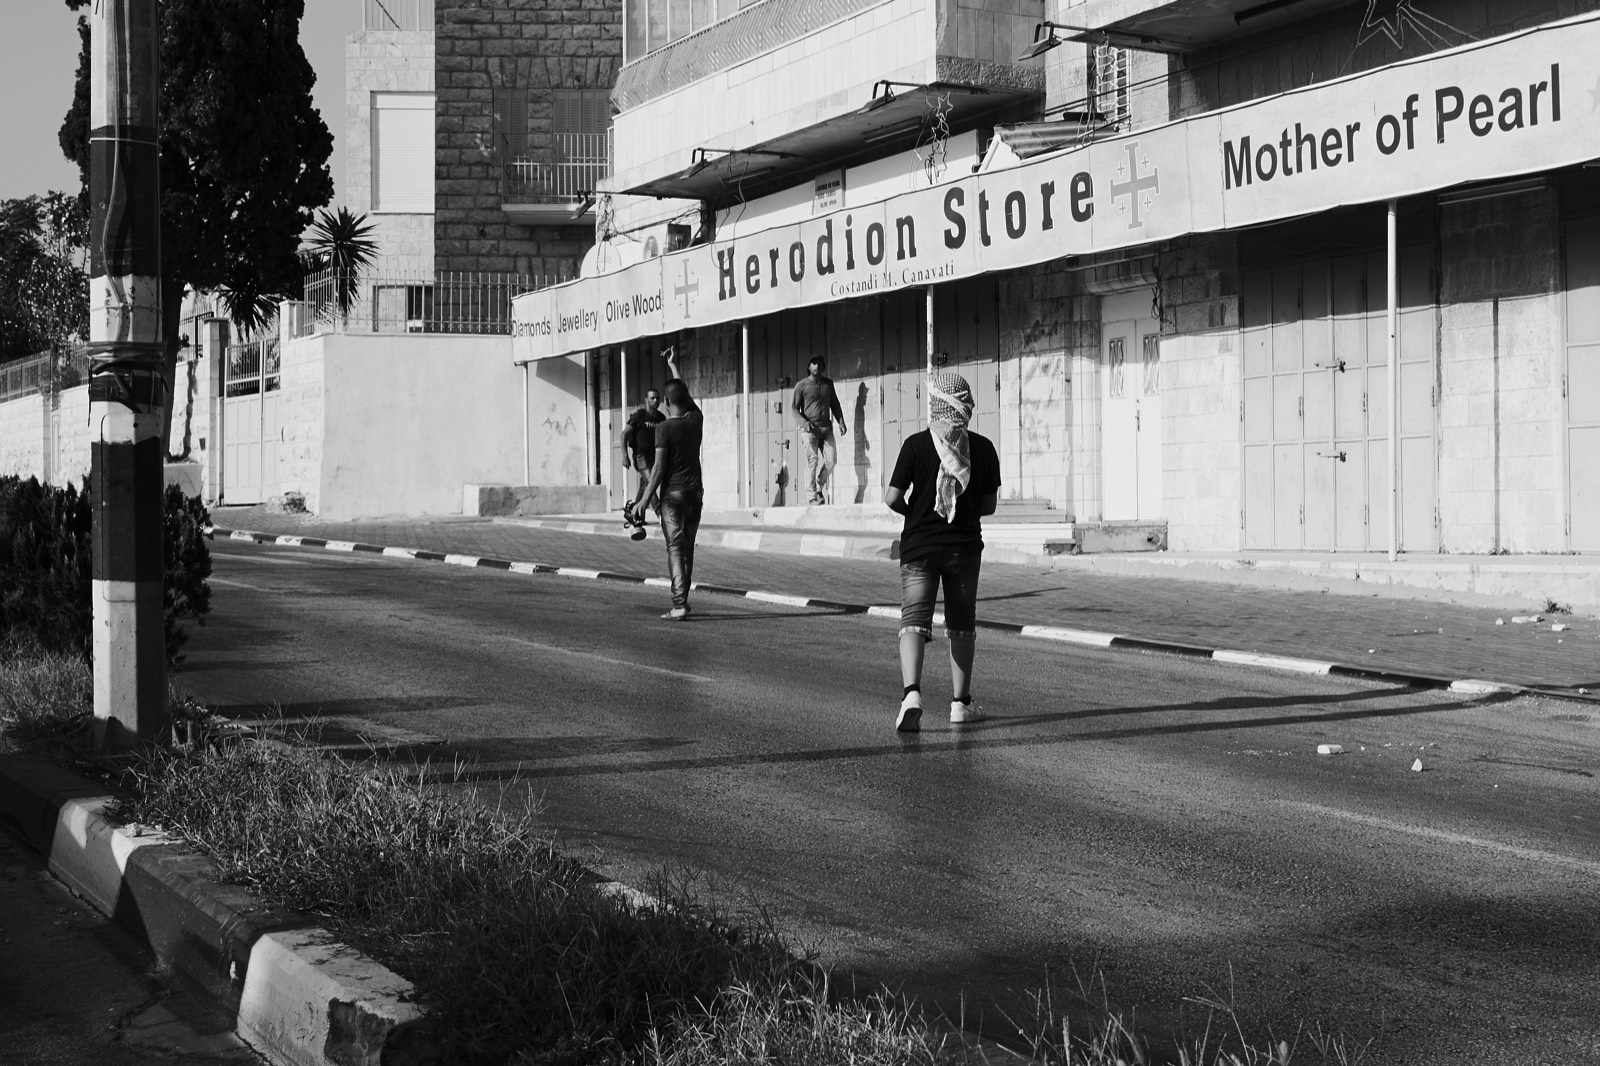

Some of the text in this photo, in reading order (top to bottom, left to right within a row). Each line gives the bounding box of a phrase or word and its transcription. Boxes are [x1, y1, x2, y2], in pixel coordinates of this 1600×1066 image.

[1223, 62, 1561, 190] Mother of Pearl
[717, 171, 1095, 301] Herodion Store
[831, 273, 878, 296] Costandi
[902, 260, 955, 284] Canavati
[512, 288, 661, 338] Diamonds Jewellery Olive Wood
